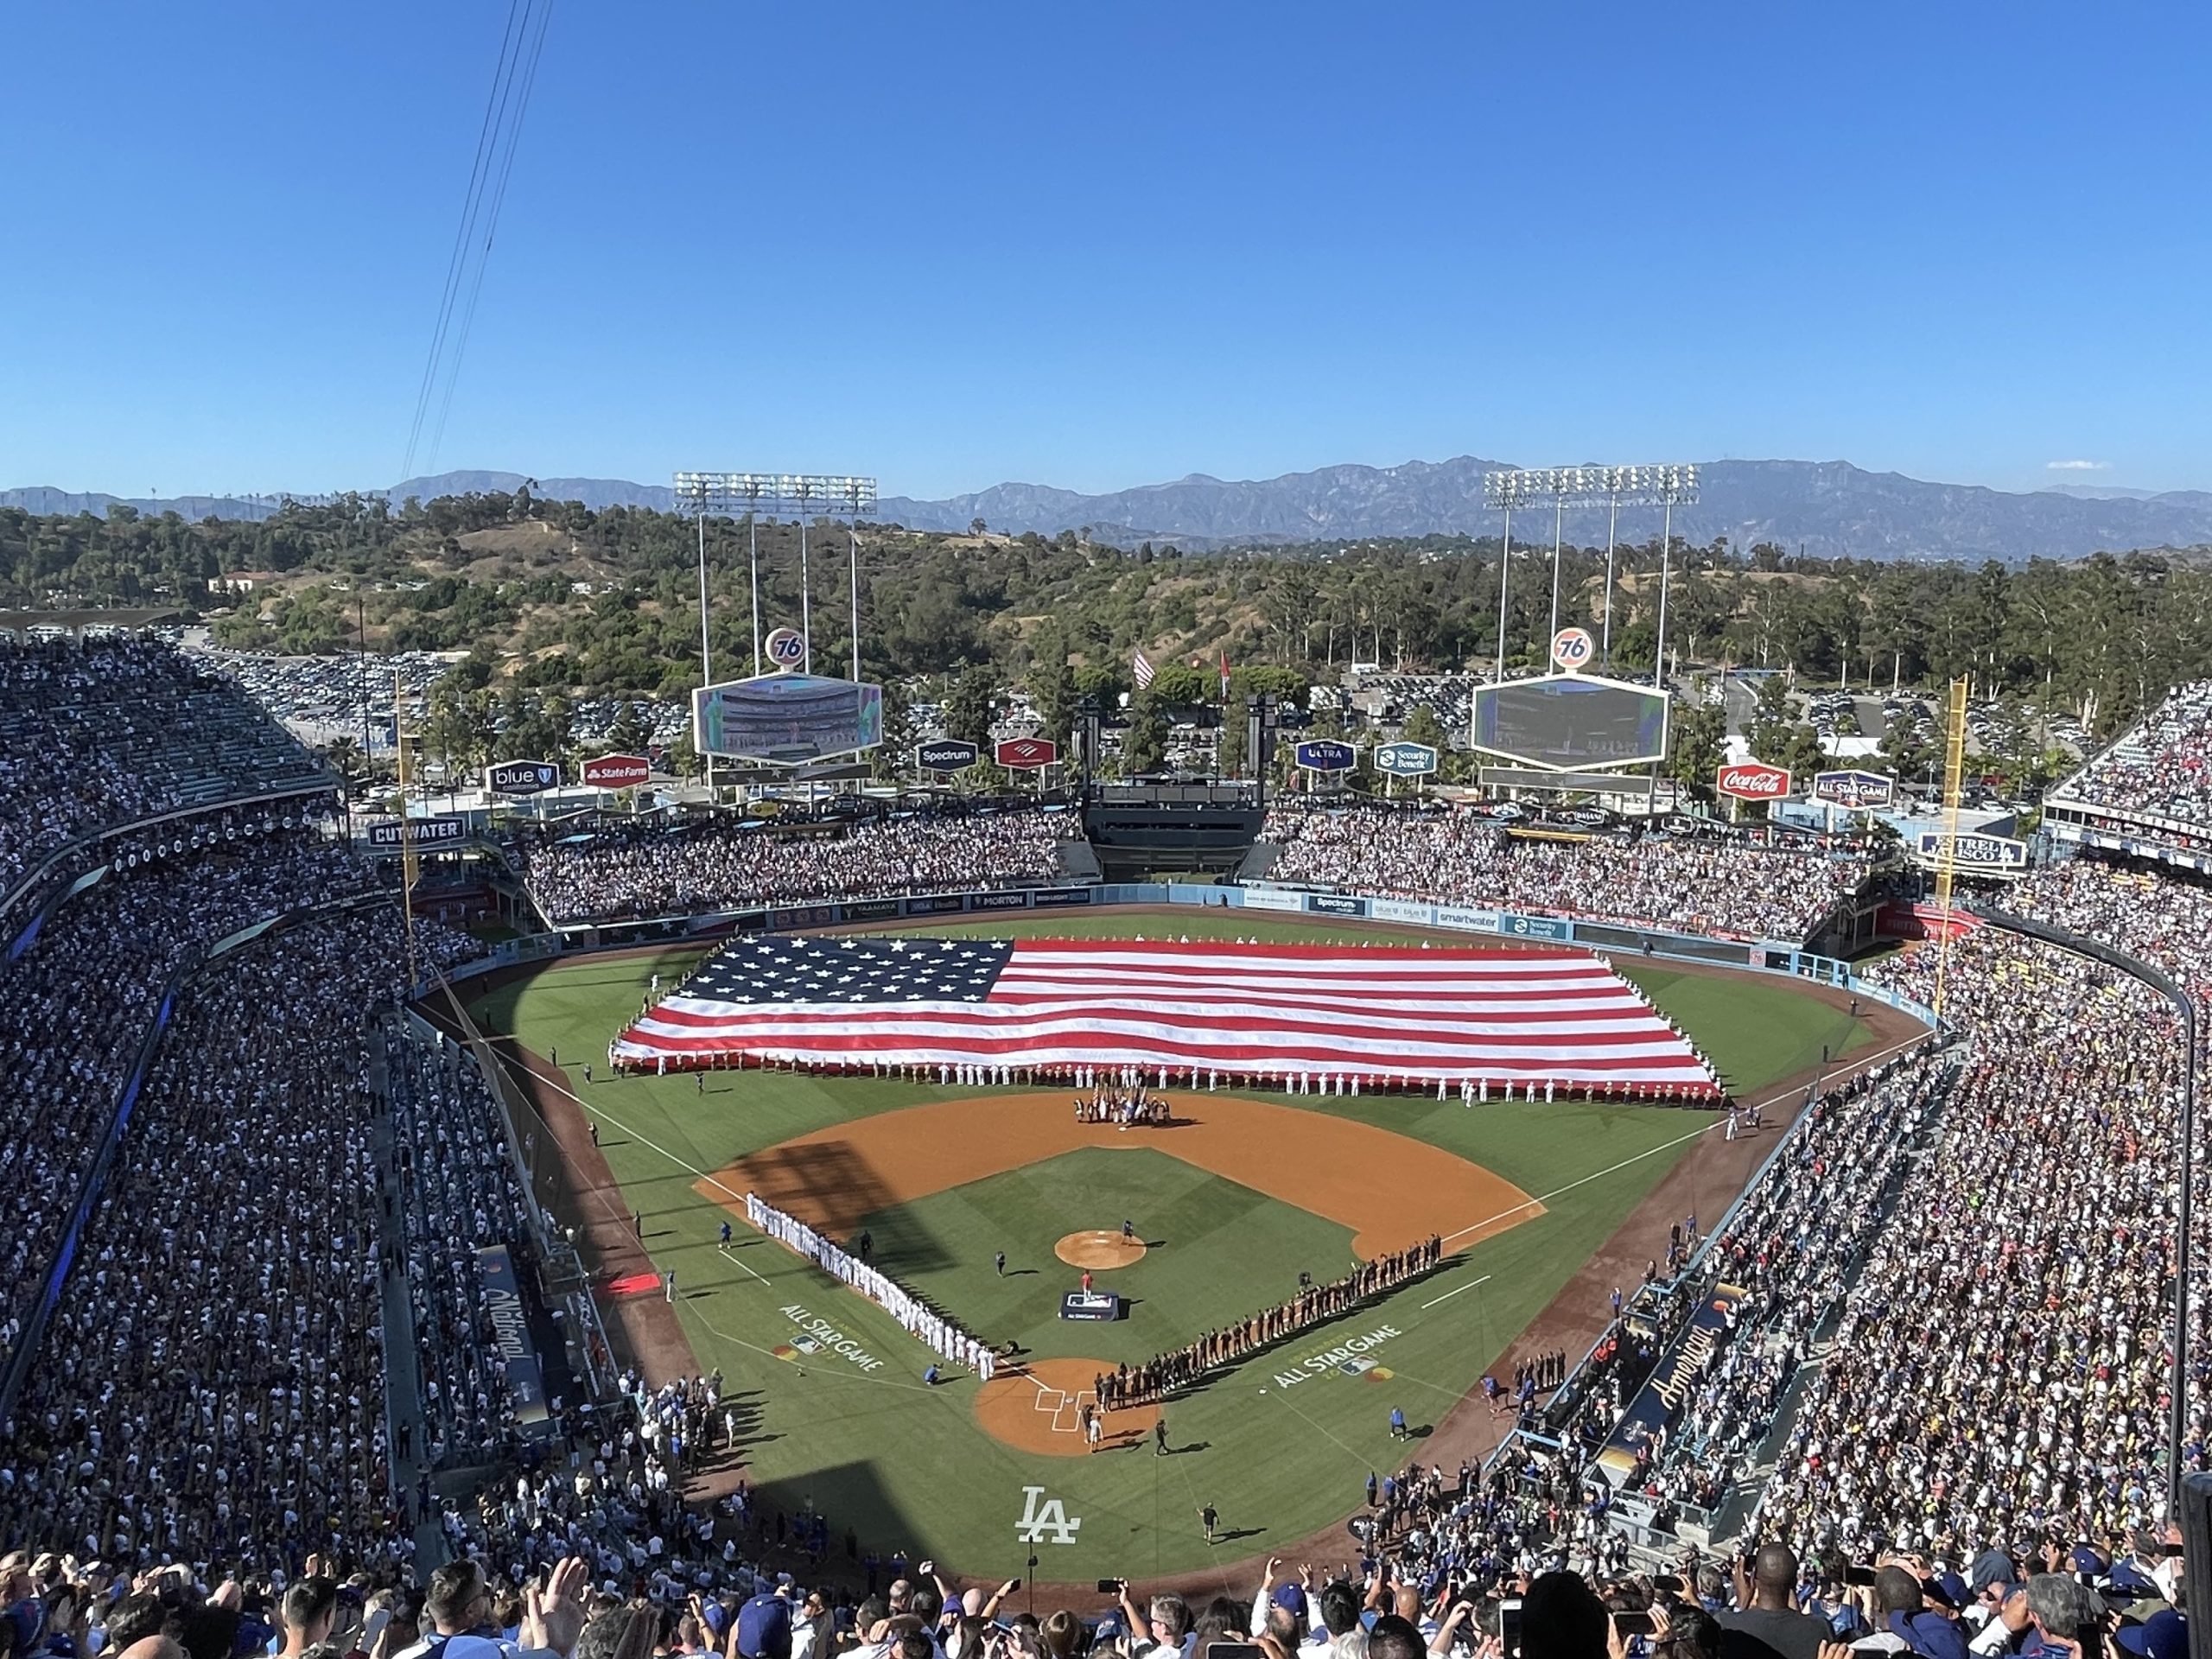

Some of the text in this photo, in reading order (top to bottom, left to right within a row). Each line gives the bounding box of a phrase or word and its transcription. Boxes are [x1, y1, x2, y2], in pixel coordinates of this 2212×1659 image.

[775, 637, 803, 658] 76
[1560, 637, 1586, 658] 76
[923, 750, 970, 762] Spectrum
[1308, 748, 1343, 759] ULTRA
[1397, 750, 1431, 763] Security
[1397, 760, 1426, 769] Benefit
[495, 768, 534, 785] blue
[1818, 782, 1888, 797] ALL STAR GAME
[375, 822, 459, 842] CUTWATER
[983, 895, 1023, 906] MORTON
[1317, 898, 1357, 908] Spectrum
[1440, 912, 1497, 927] smartwater
[1529, 920, 1556, 931] Security
[1529, 928, 1553, 937] Benefit
[779, 1305, 811, 1323] ALL
[803, 1319, 843, 1344] STAR
[835, 1340, 884, 1372] GAME
[1273, 1325, 1402, 1389] ALL STAR GAME
[1014, 1485, 1081, 1544] LA
